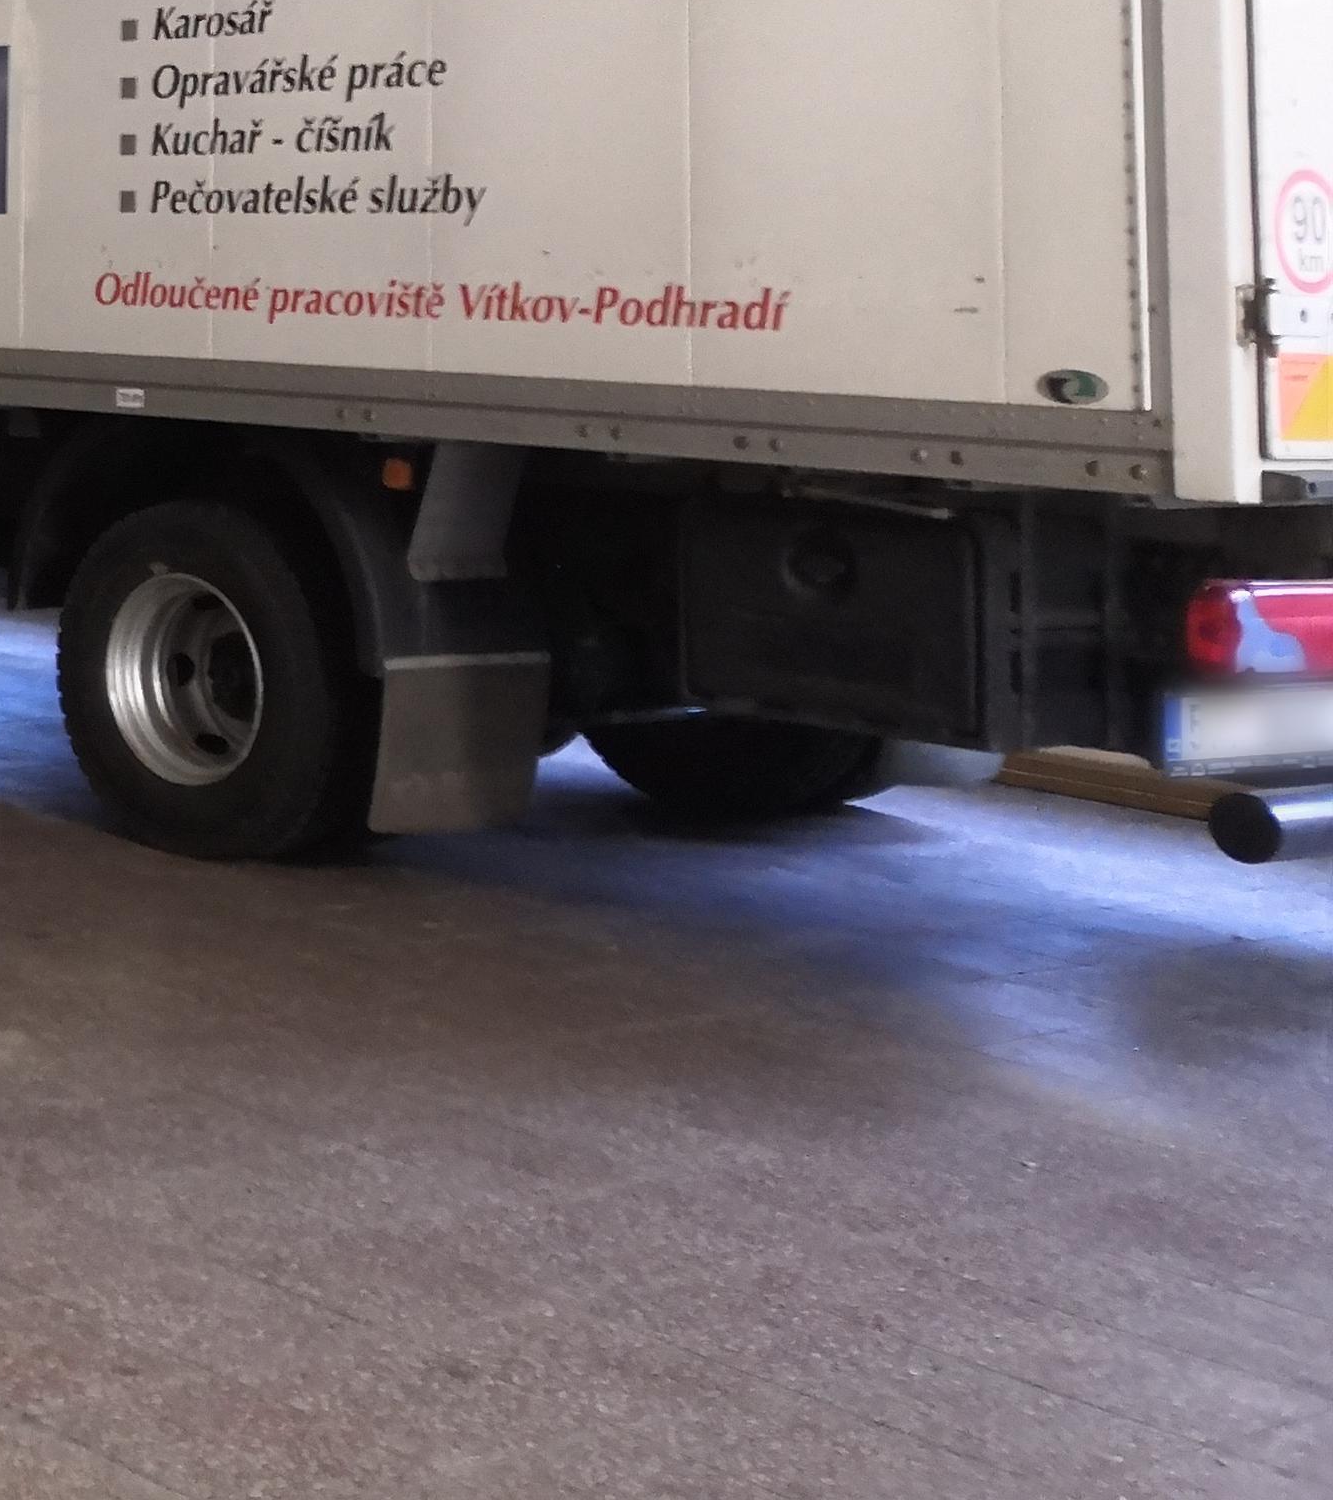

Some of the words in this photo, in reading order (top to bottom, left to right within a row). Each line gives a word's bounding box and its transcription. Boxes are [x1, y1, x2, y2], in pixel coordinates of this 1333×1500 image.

[151, 52, 338, 109] Opravářské
[345, 50, 448, 103] práce
[150, 117, 264, 157] Kuchař
[295, 111, 397, 153] číšník
[149, 174, 360, 215] Pečovatelské
[366, 172, 487, 228] služby
[1293, 195, 1326, 243] 90
[1298, 251, 1324, 273] km
[94, 271, 262, 312] Odloučené
[268, 279, 446, 325] pracoviště
[459, 280, 792, 332] Vítkov-Podhradí
